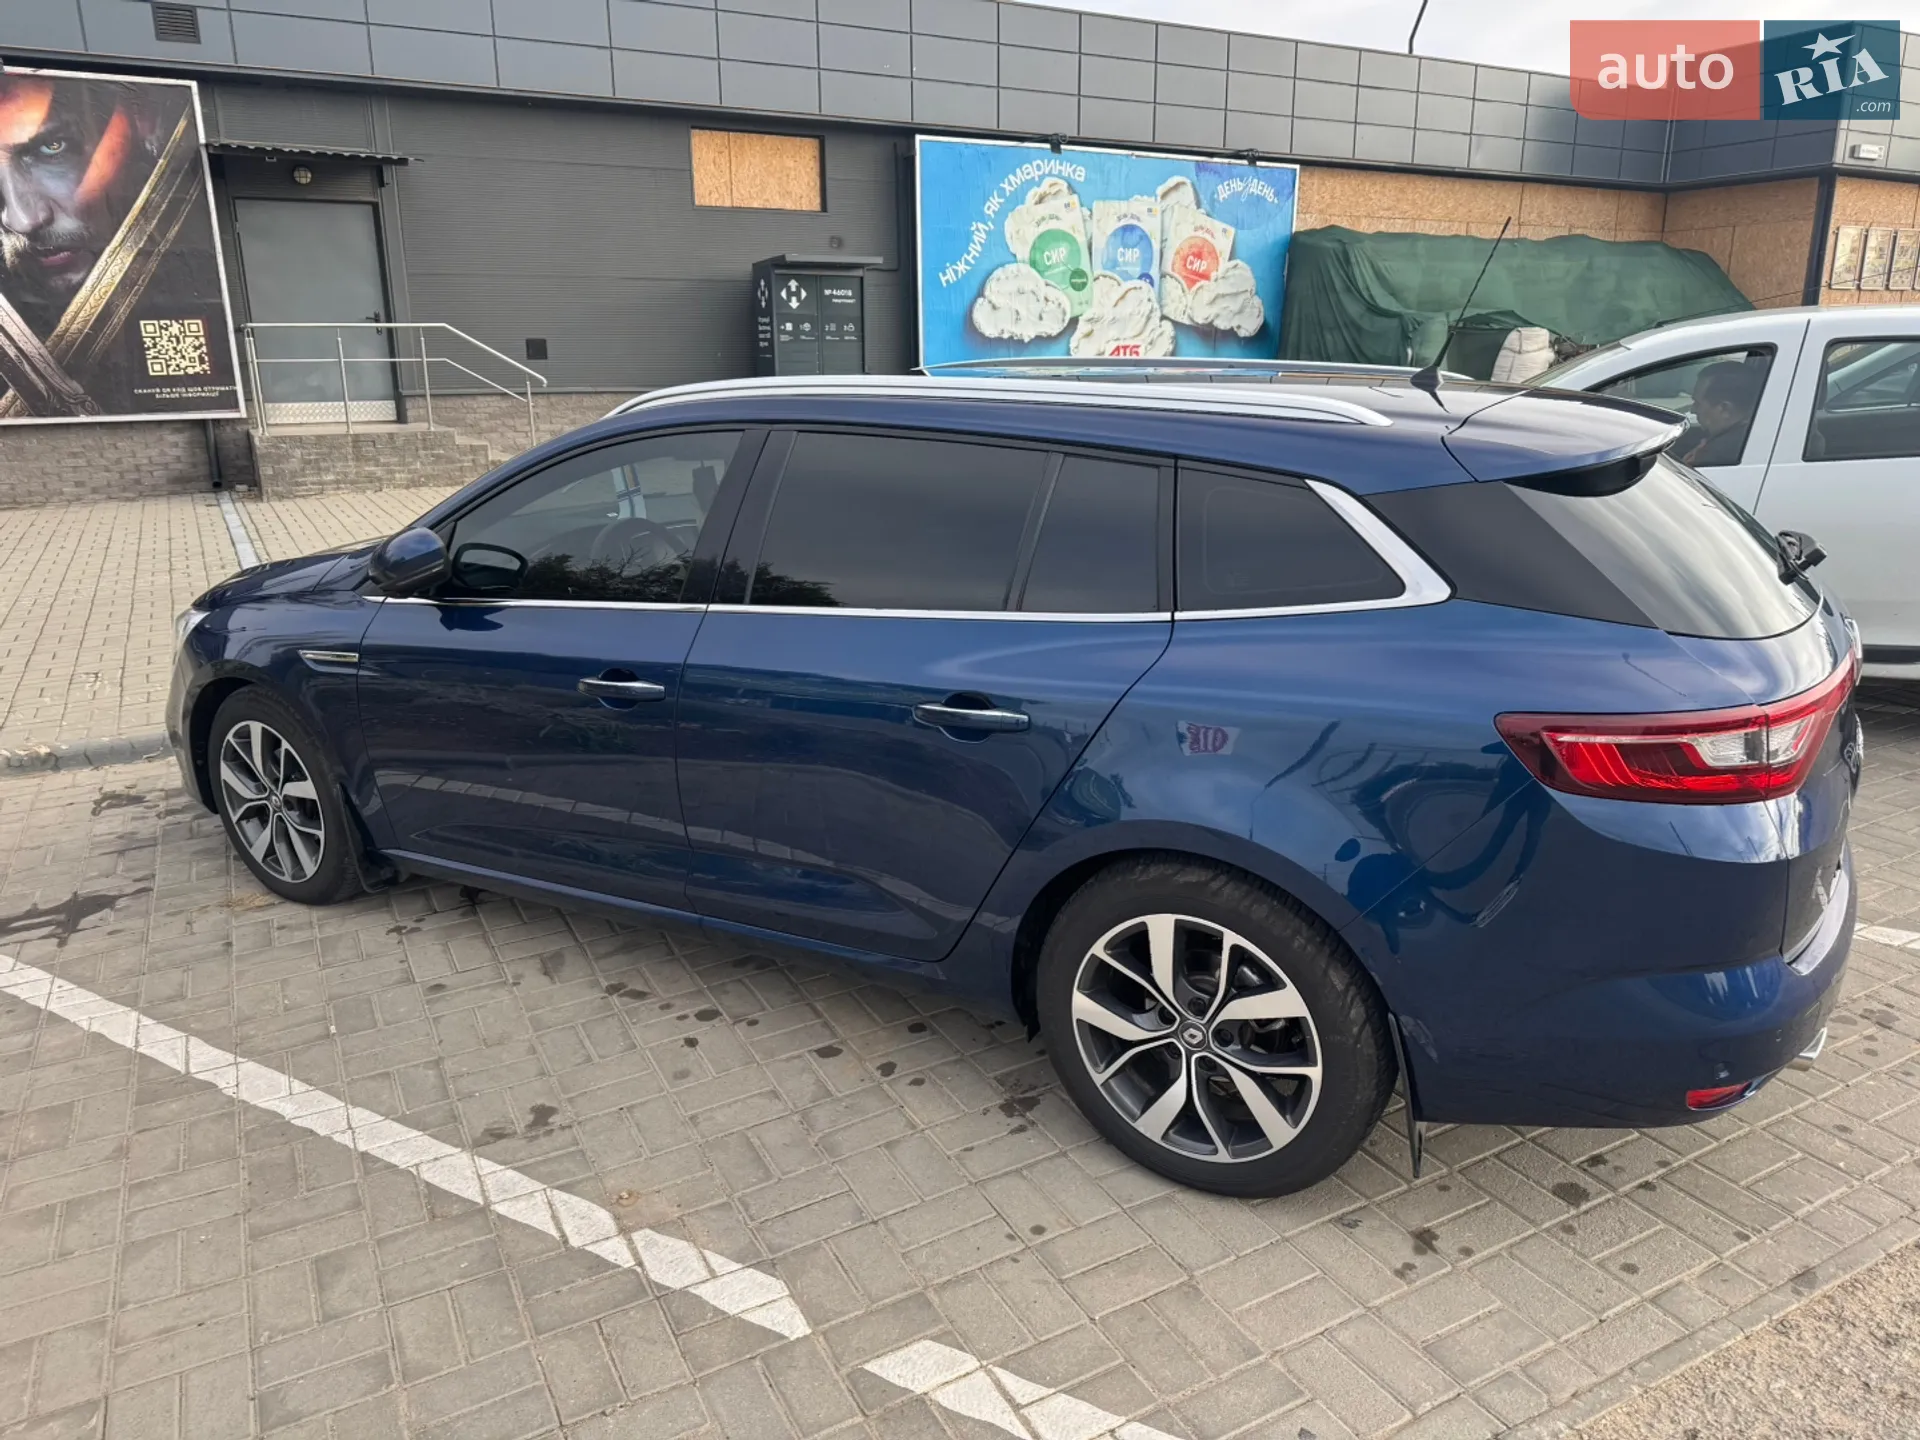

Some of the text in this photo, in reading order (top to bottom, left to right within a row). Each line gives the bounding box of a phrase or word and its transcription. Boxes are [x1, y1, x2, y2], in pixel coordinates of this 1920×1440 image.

[1217, 177, 1243, 202] ДЕНЬ
[1250, 178, 1275, 203] ДЕНЬ
[1043, 247, 1067, 266] СИР
[1117, 247, 1140, 262] СИР
[1186, 256, 1208, 273] СИР
